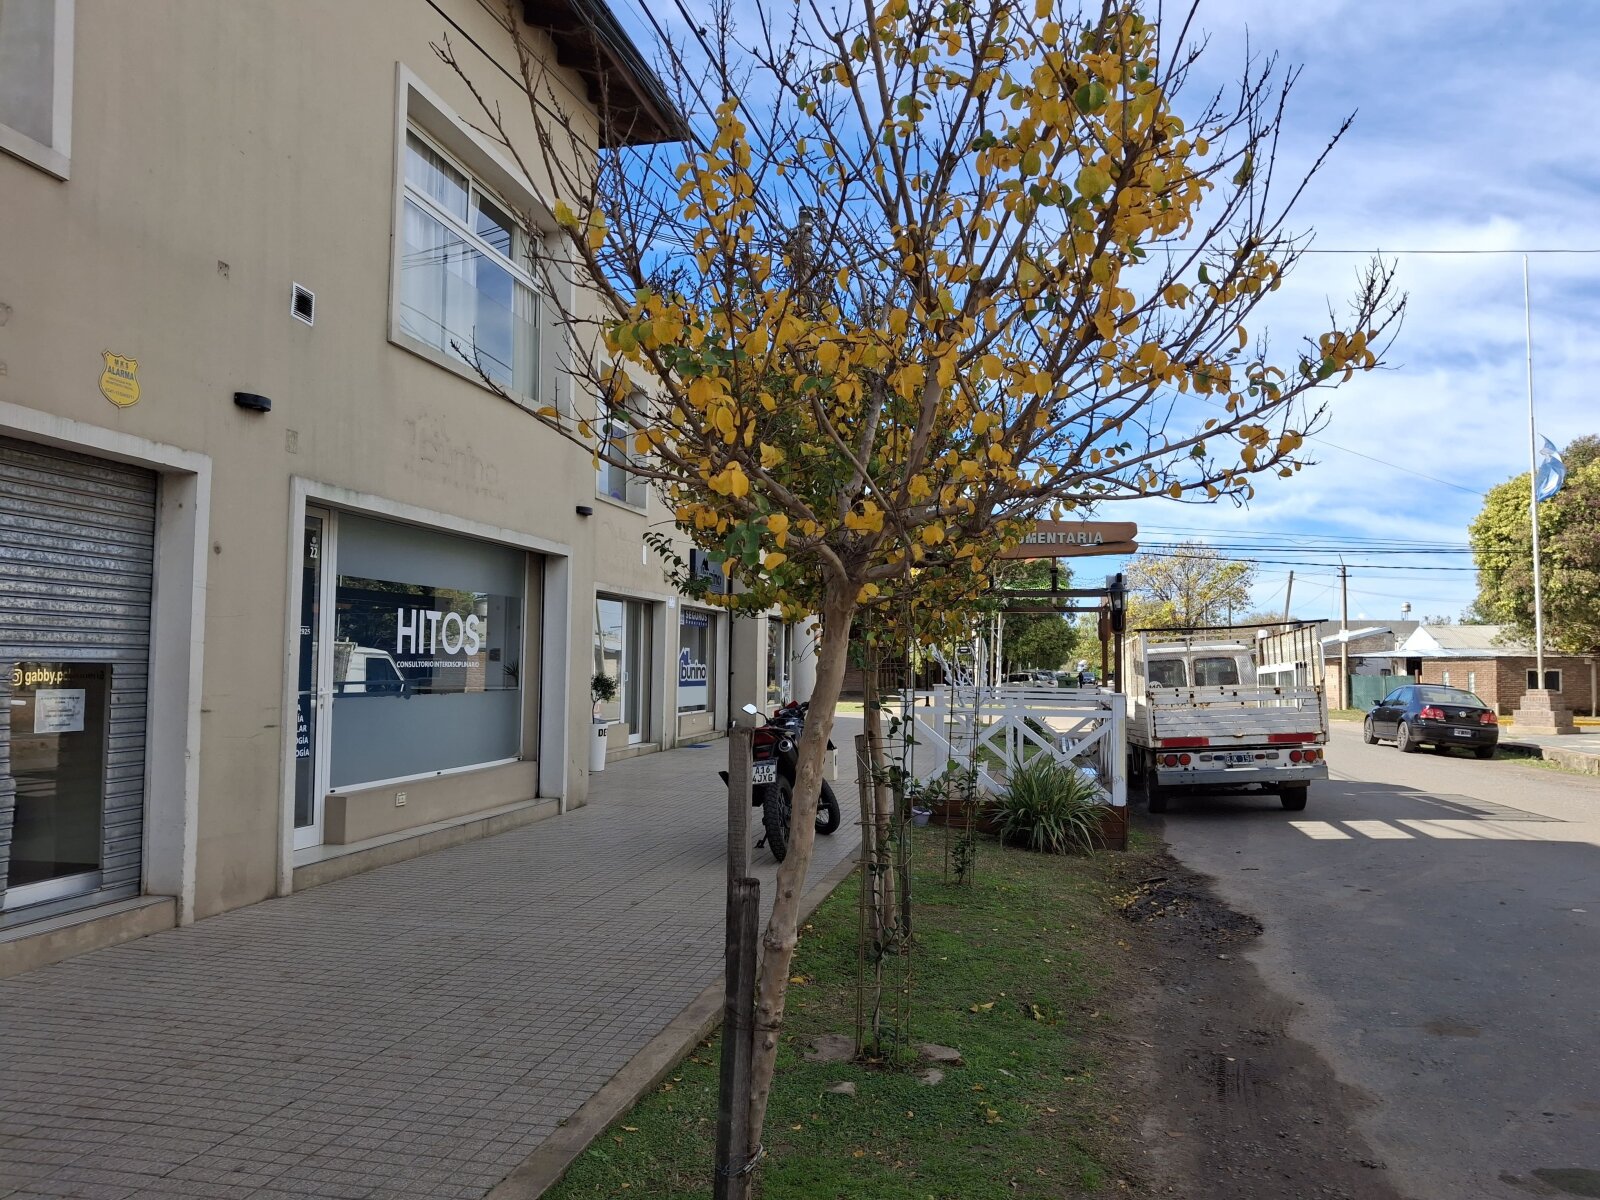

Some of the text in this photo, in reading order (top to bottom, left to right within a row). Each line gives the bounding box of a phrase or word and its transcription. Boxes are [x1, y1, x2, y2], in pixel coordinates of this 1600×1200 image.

[108, 365, 134, 381] ALARMA
[310, 547, 318, 558] 22
[396, 607, 480, 656] HITOS
[396, 660, 433, 668] CONSULTORIO
[755, 766, 771, 774] A16
[752, 773, 773, 783] 4JXG
